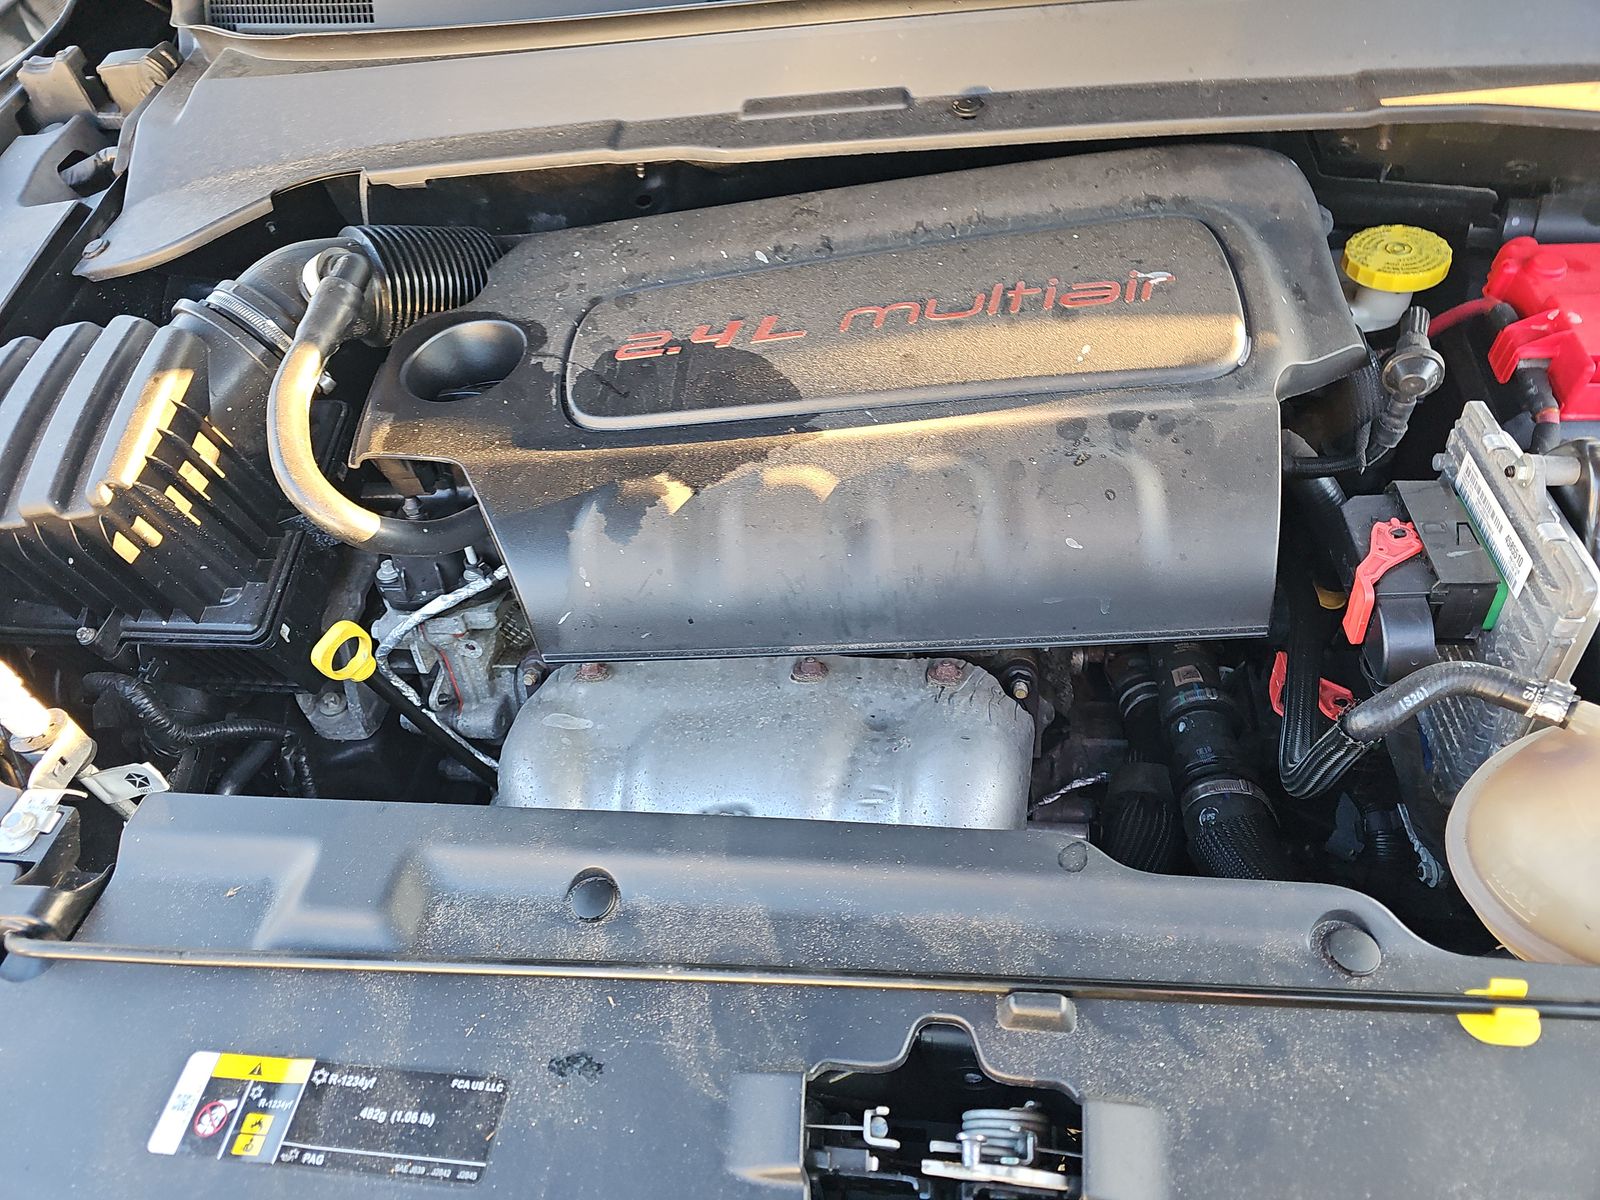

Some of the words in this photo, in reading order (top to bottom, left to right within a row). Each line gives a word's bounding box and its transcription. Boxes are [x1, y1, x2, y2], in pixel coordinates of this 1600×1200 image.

[839, 270, 1177, 332] multiair
[327, 1073, 378, 1091] R-1234yf
[450, 1078, 470, 1090] FCA
[485, 1082, 505, 1093] LLC
[301, 1152, 325, 1166] PAG
